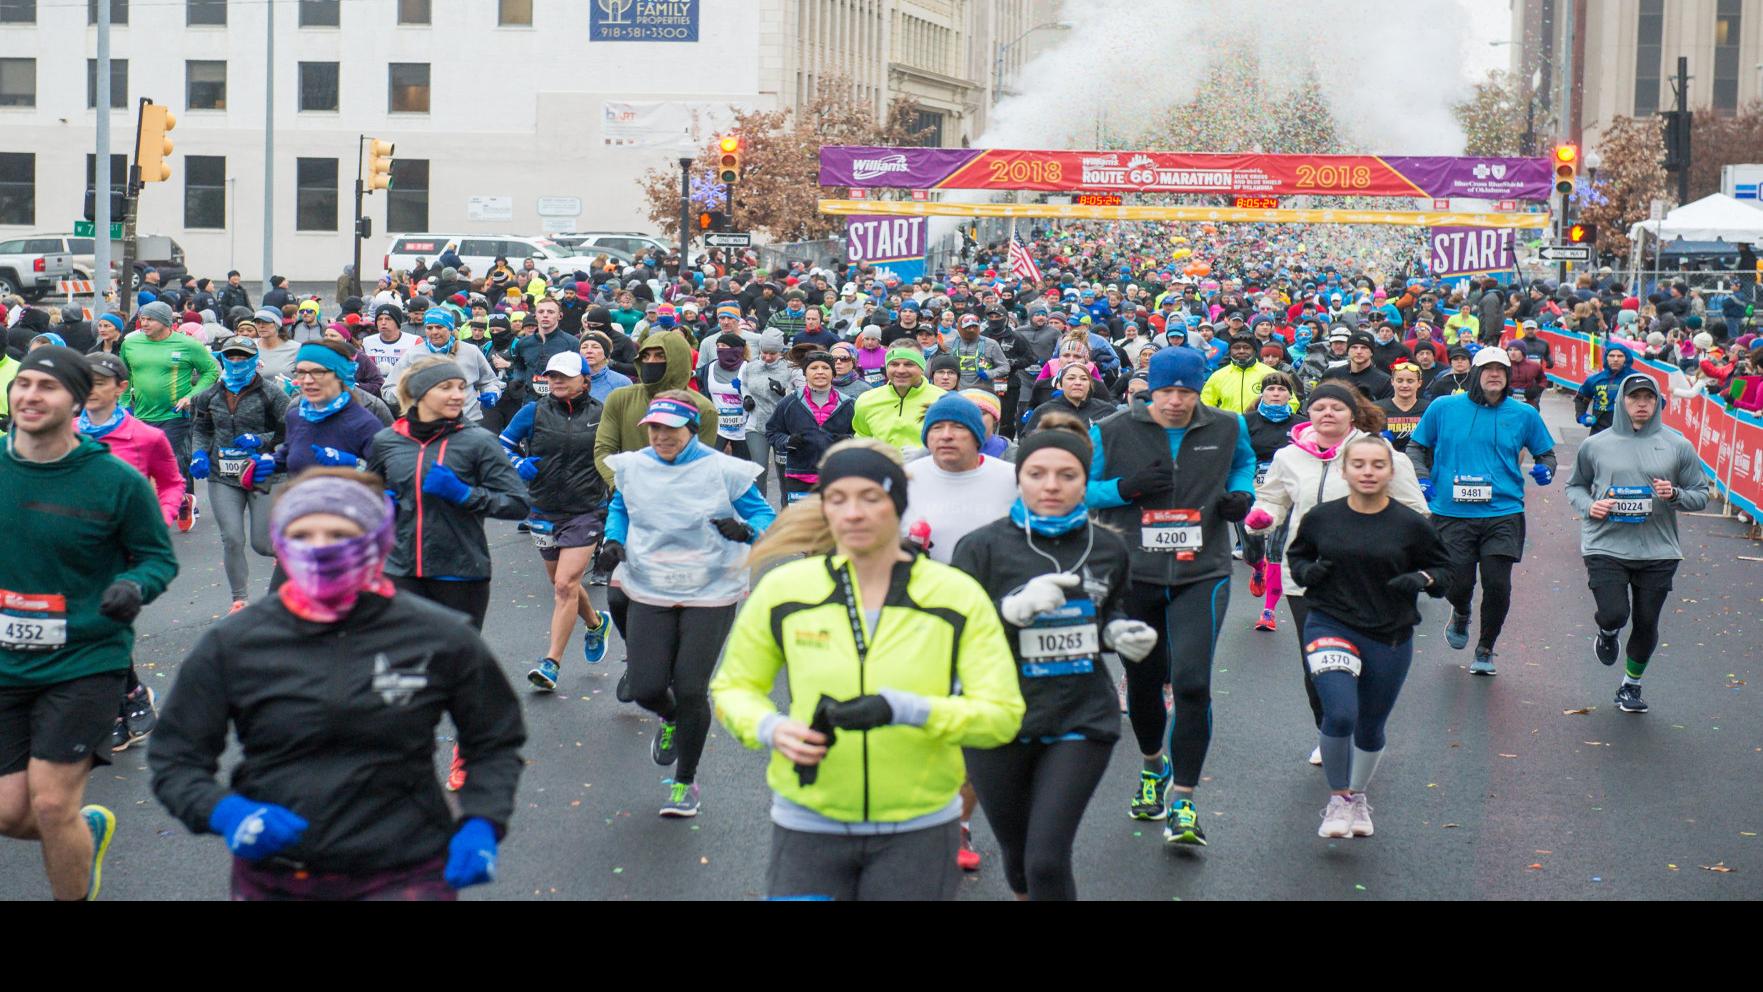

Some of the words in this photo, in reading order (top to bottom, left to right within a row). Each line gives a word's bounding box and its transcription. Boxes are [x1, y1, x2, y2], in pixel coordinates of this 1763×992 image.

[636, 3, 691, 16] FAMILY
[636, 16, 691, 25] PROPERTIES
[600, 27, 688, 38] 918-581-3500
[853, 157, 910, 173] Williams
[989, 159, 1063, 183] 2018
[1082, 170, 1124, 184] ROUTE
[1129, 170, 1154, 183] 66
[1159, 171, 1232, 186] MARATHON
[1296, 164, 1371, 188] 2018
[848, 217, 923, 261] START
[1433, 227, 1513, 275] START
[1461, 488, 1482, 498] 9481
[1616, 501, 1643, 511] 10224
[1155, 531, 1187, 545] 4200
[6, 622, 44, 640] 4352
[1038, 632, 1083, 652] 10263
[1320, 654, 1350, 666] 4370
